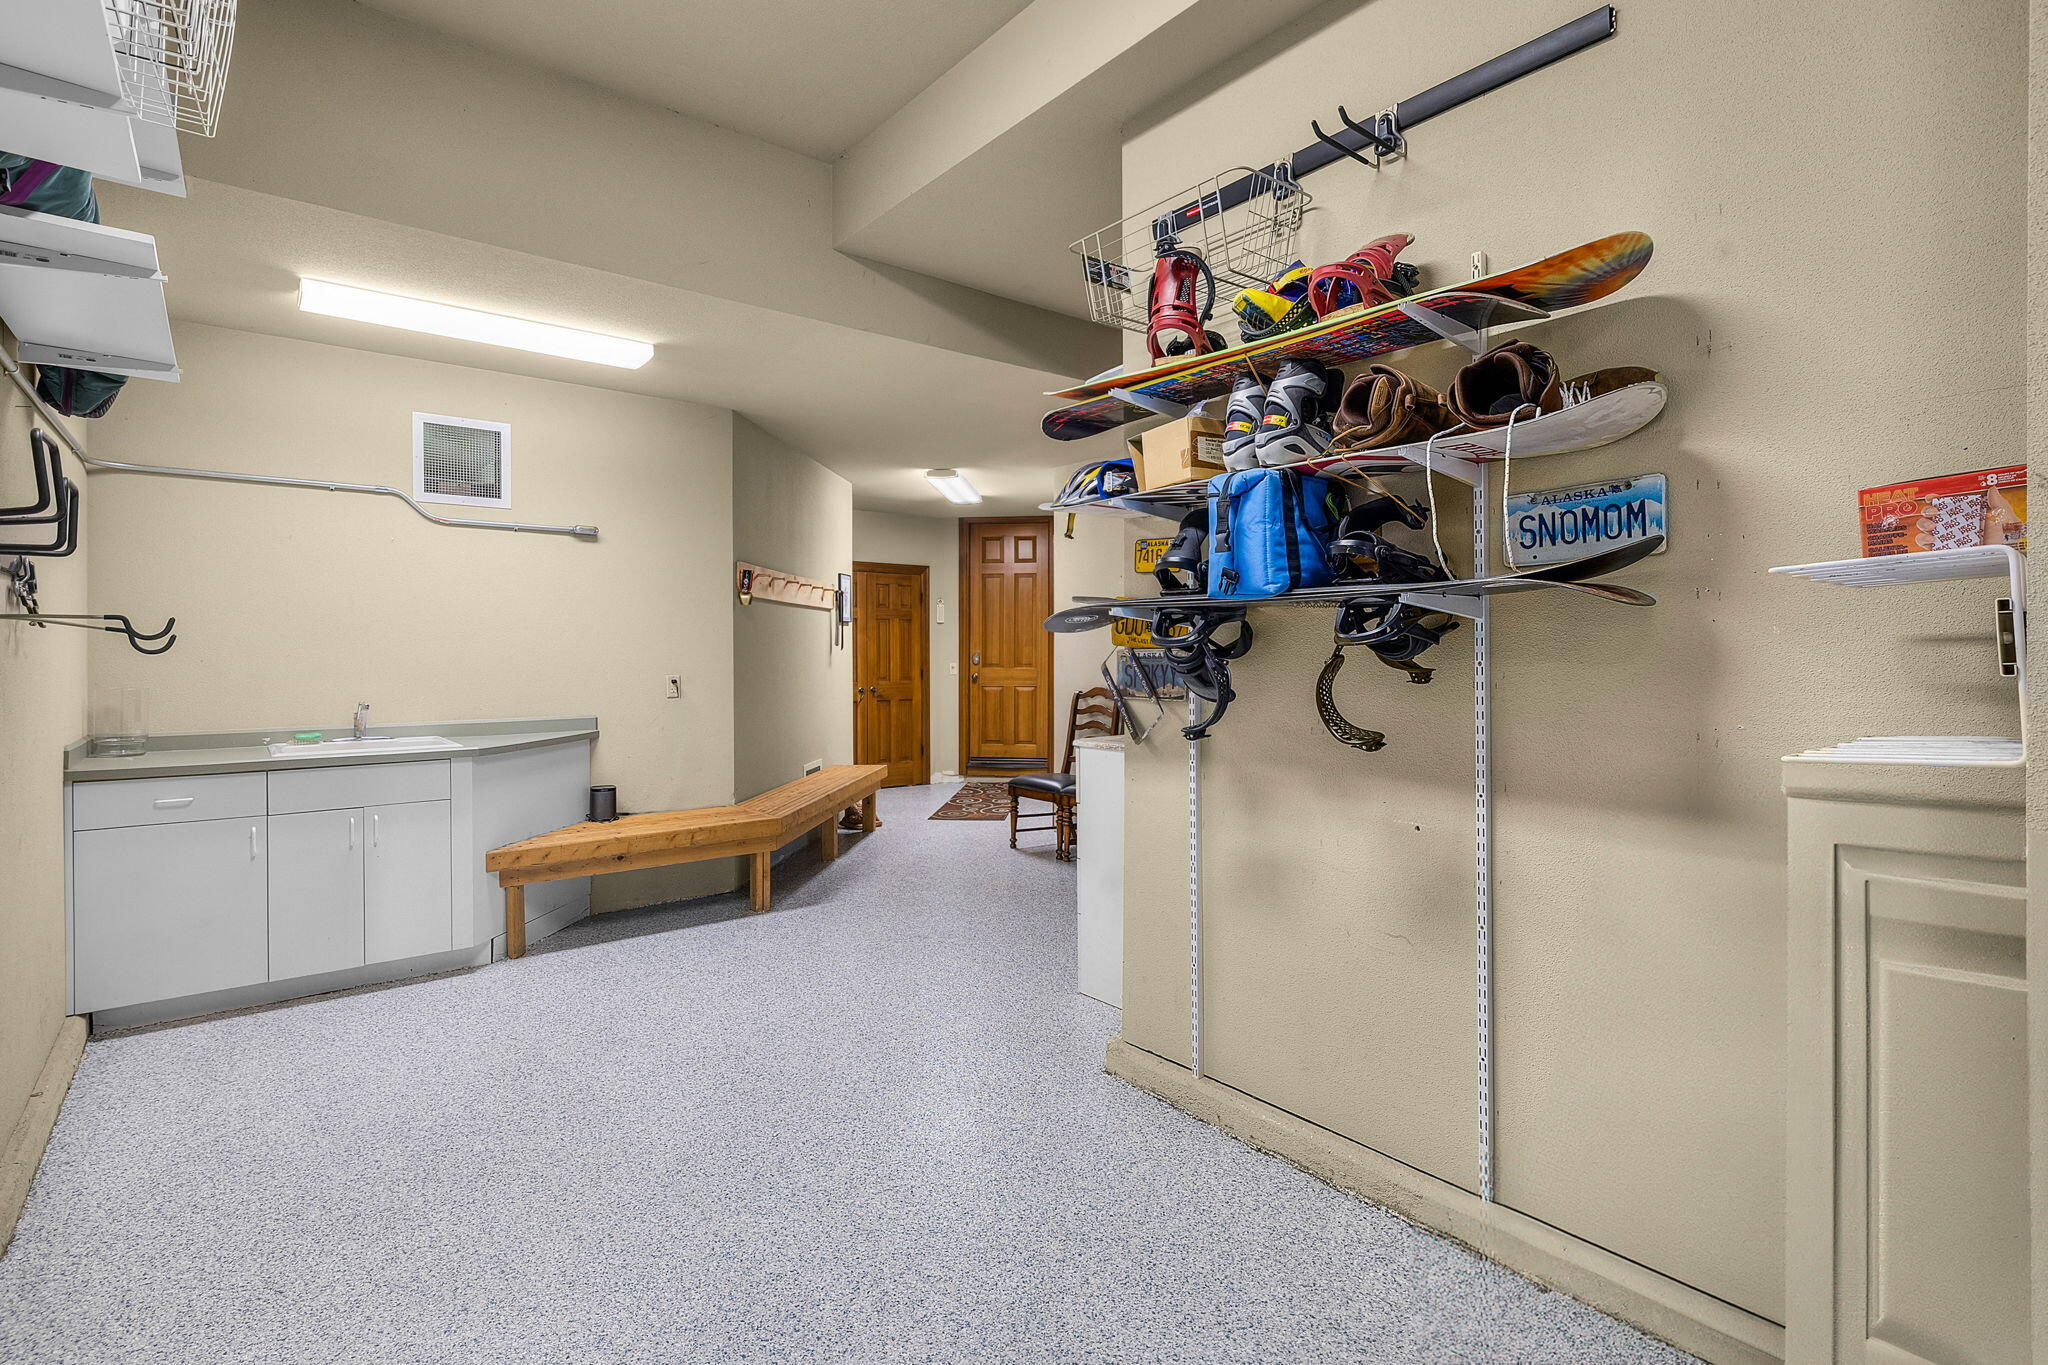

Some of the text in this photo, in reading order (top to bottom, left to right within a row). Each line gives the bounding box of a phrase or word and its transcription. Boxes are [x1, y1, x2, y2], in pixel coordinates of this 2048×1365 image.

[1987, 474, 1997, 485] 8
[1541, 488, 1608, 505] ALASKA
[1864, 487, 1918, 506] HEAT
[1866, 500, 1918, 521] PRO
[1946, 505, 1962, 514] HEAT
[1948, 508, 1965, 517] PRO
[1962, 509, 1979, 518] HEAT
[1965, 512, 1982, 522] PRO
[1519, 499, 1647, 550] SNOMOM
[1942, 518, 1958, 527] HEAT
[1944, 521, 1961, 531] PRO
[1958, 521, 1974, 531] HEAT
[1937, 530, 1954, 540] HEAT
[1960, 525, 1977, 535] PRO
[1940, 535, 1956, 544] PRO
[1953, 535, 1970, 544] HEAT
[1956, 538, 1973, 548] PRO
